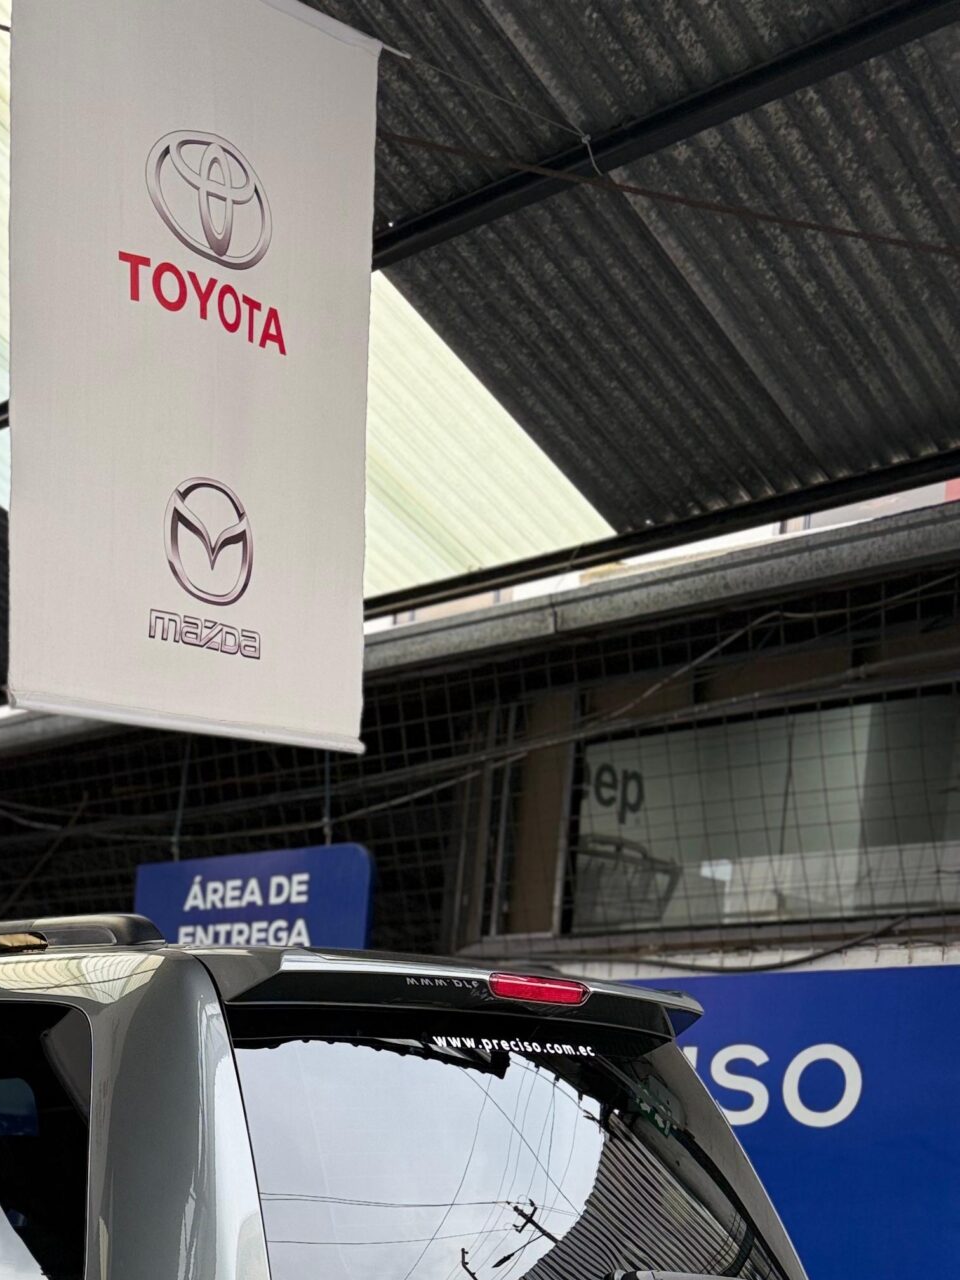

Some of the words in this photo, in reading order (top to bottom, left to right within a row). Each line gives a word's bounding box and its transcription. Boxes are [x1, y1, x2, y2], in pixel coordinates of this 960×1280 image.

[118, 251, 287, 355] TOYOTA
[148, 608, 261, 660] mazda
[581, 763, 645, 825] ep
[183, 875, 263, 911] ÁREA
[269, 873, 310, 905] DE
[178, 918, 311, 946] ENTREGA
[432, 1035, 595, 1057] www.preciso.com.ec
[682, 1043, 862, 1128] SO
